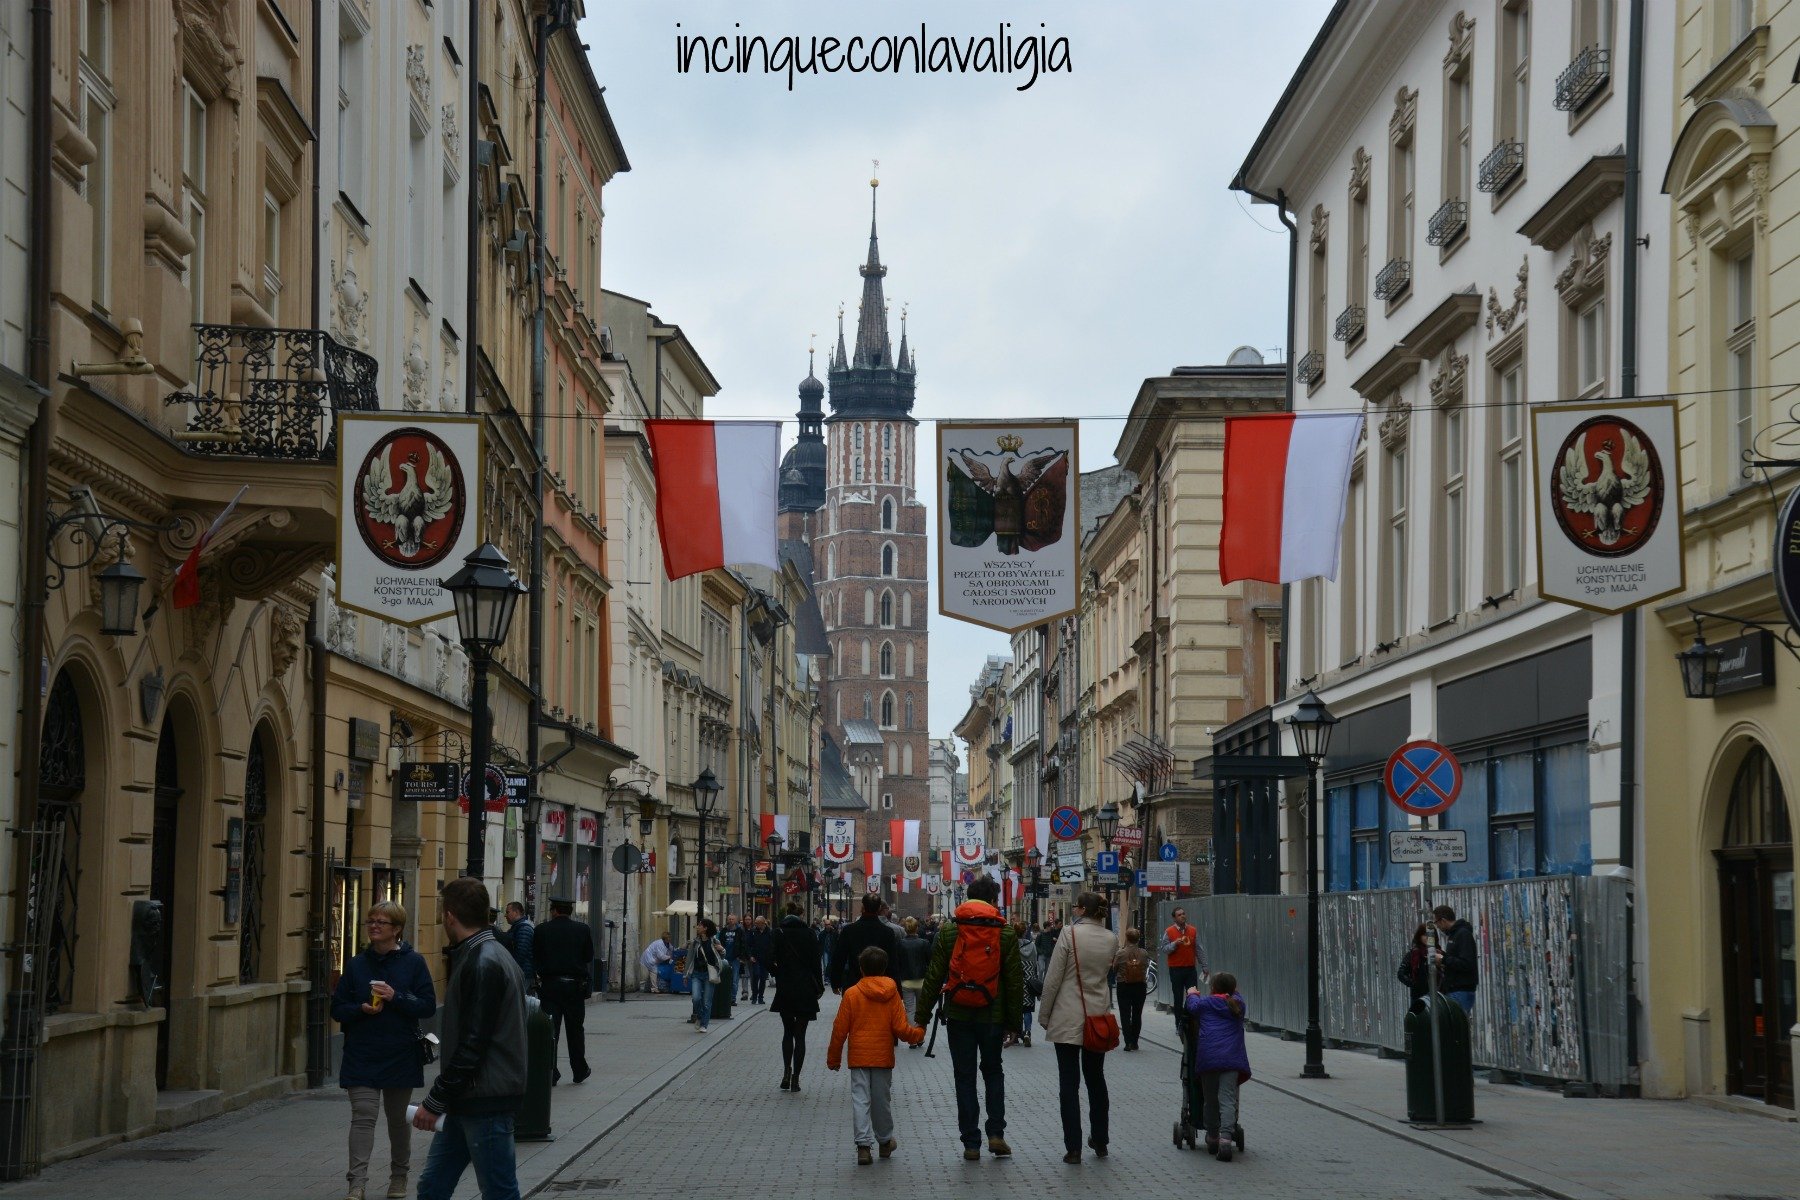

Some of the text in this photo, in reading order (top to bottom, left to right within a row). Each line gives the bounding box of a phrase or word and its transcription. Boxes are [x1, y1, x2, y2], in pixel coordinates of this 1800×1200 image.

[983, 560, 1035, 569] WSZYSCY
[1578, 564, 1644, 574] UCHWALENIE
[954, 569, 1065, 579] PRZETO OBYWATELE
[376, 576, 441, 587] UCHWALENIE
[969, 578, 1050, 589] SĄ OBROŃCAMI
[1576, 574, 1646, 585] KONSTYTUCJI
[374, 587, 443, 597] KONSTYTUCJI
[963, 587, 1056, 597] CAŁOŚCI SWOBÓD
[1585, 585, 1638, 596] 3-go MAJA
[381, 595, 434, 606] 3-go MAJA
[972, 597, 1047, 606] NARODOWYCH
[506, 788, 517, 796] AB
[1102, 853, 1114, 871] P
